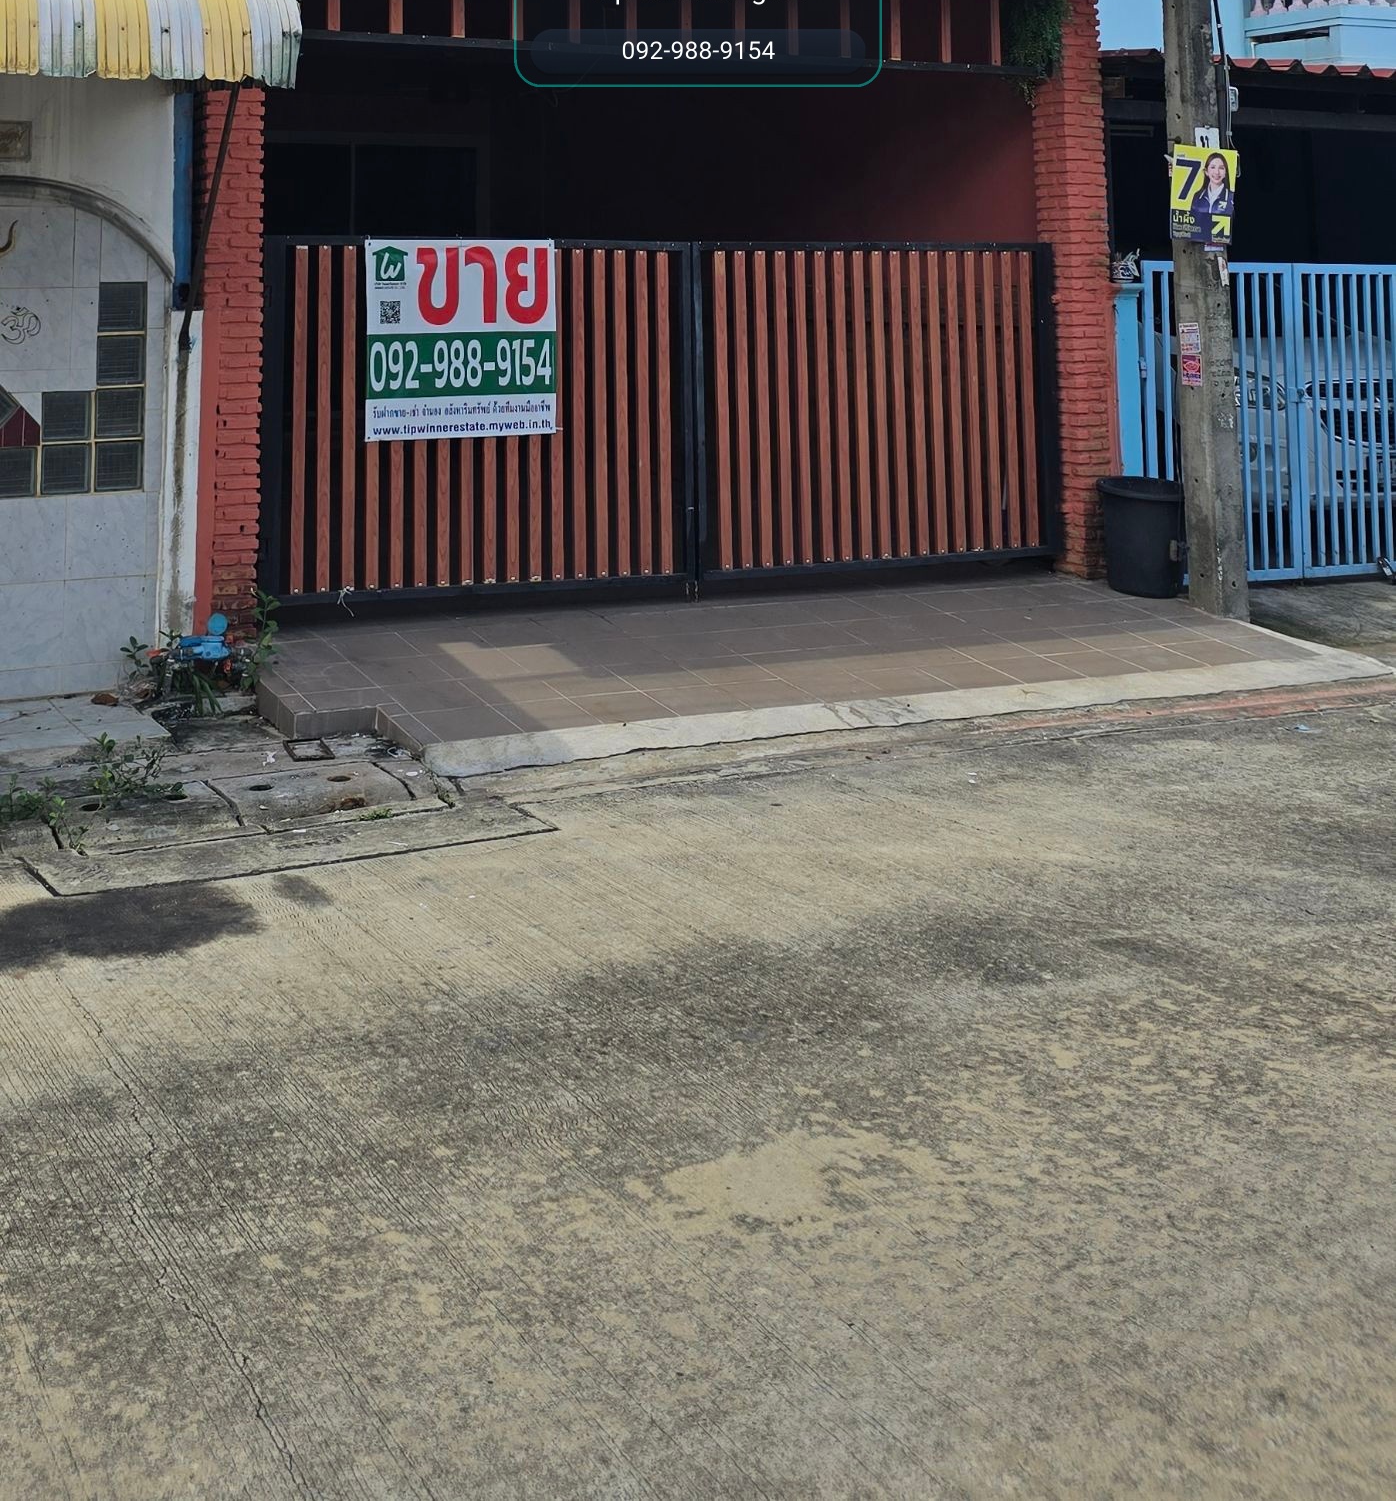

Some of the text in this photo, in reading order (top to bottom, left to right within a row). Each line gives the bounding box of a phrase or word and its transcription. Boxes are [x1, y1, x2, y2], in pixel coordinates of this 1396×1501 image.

[1175, 158, 1202, 200] 7
[416, 246, 549, 326] ขาย
[369, 338, 552, 392] 092-988-9154
[373, 419, 551, 436] www.tipwinnerestate.myweb.in.th
